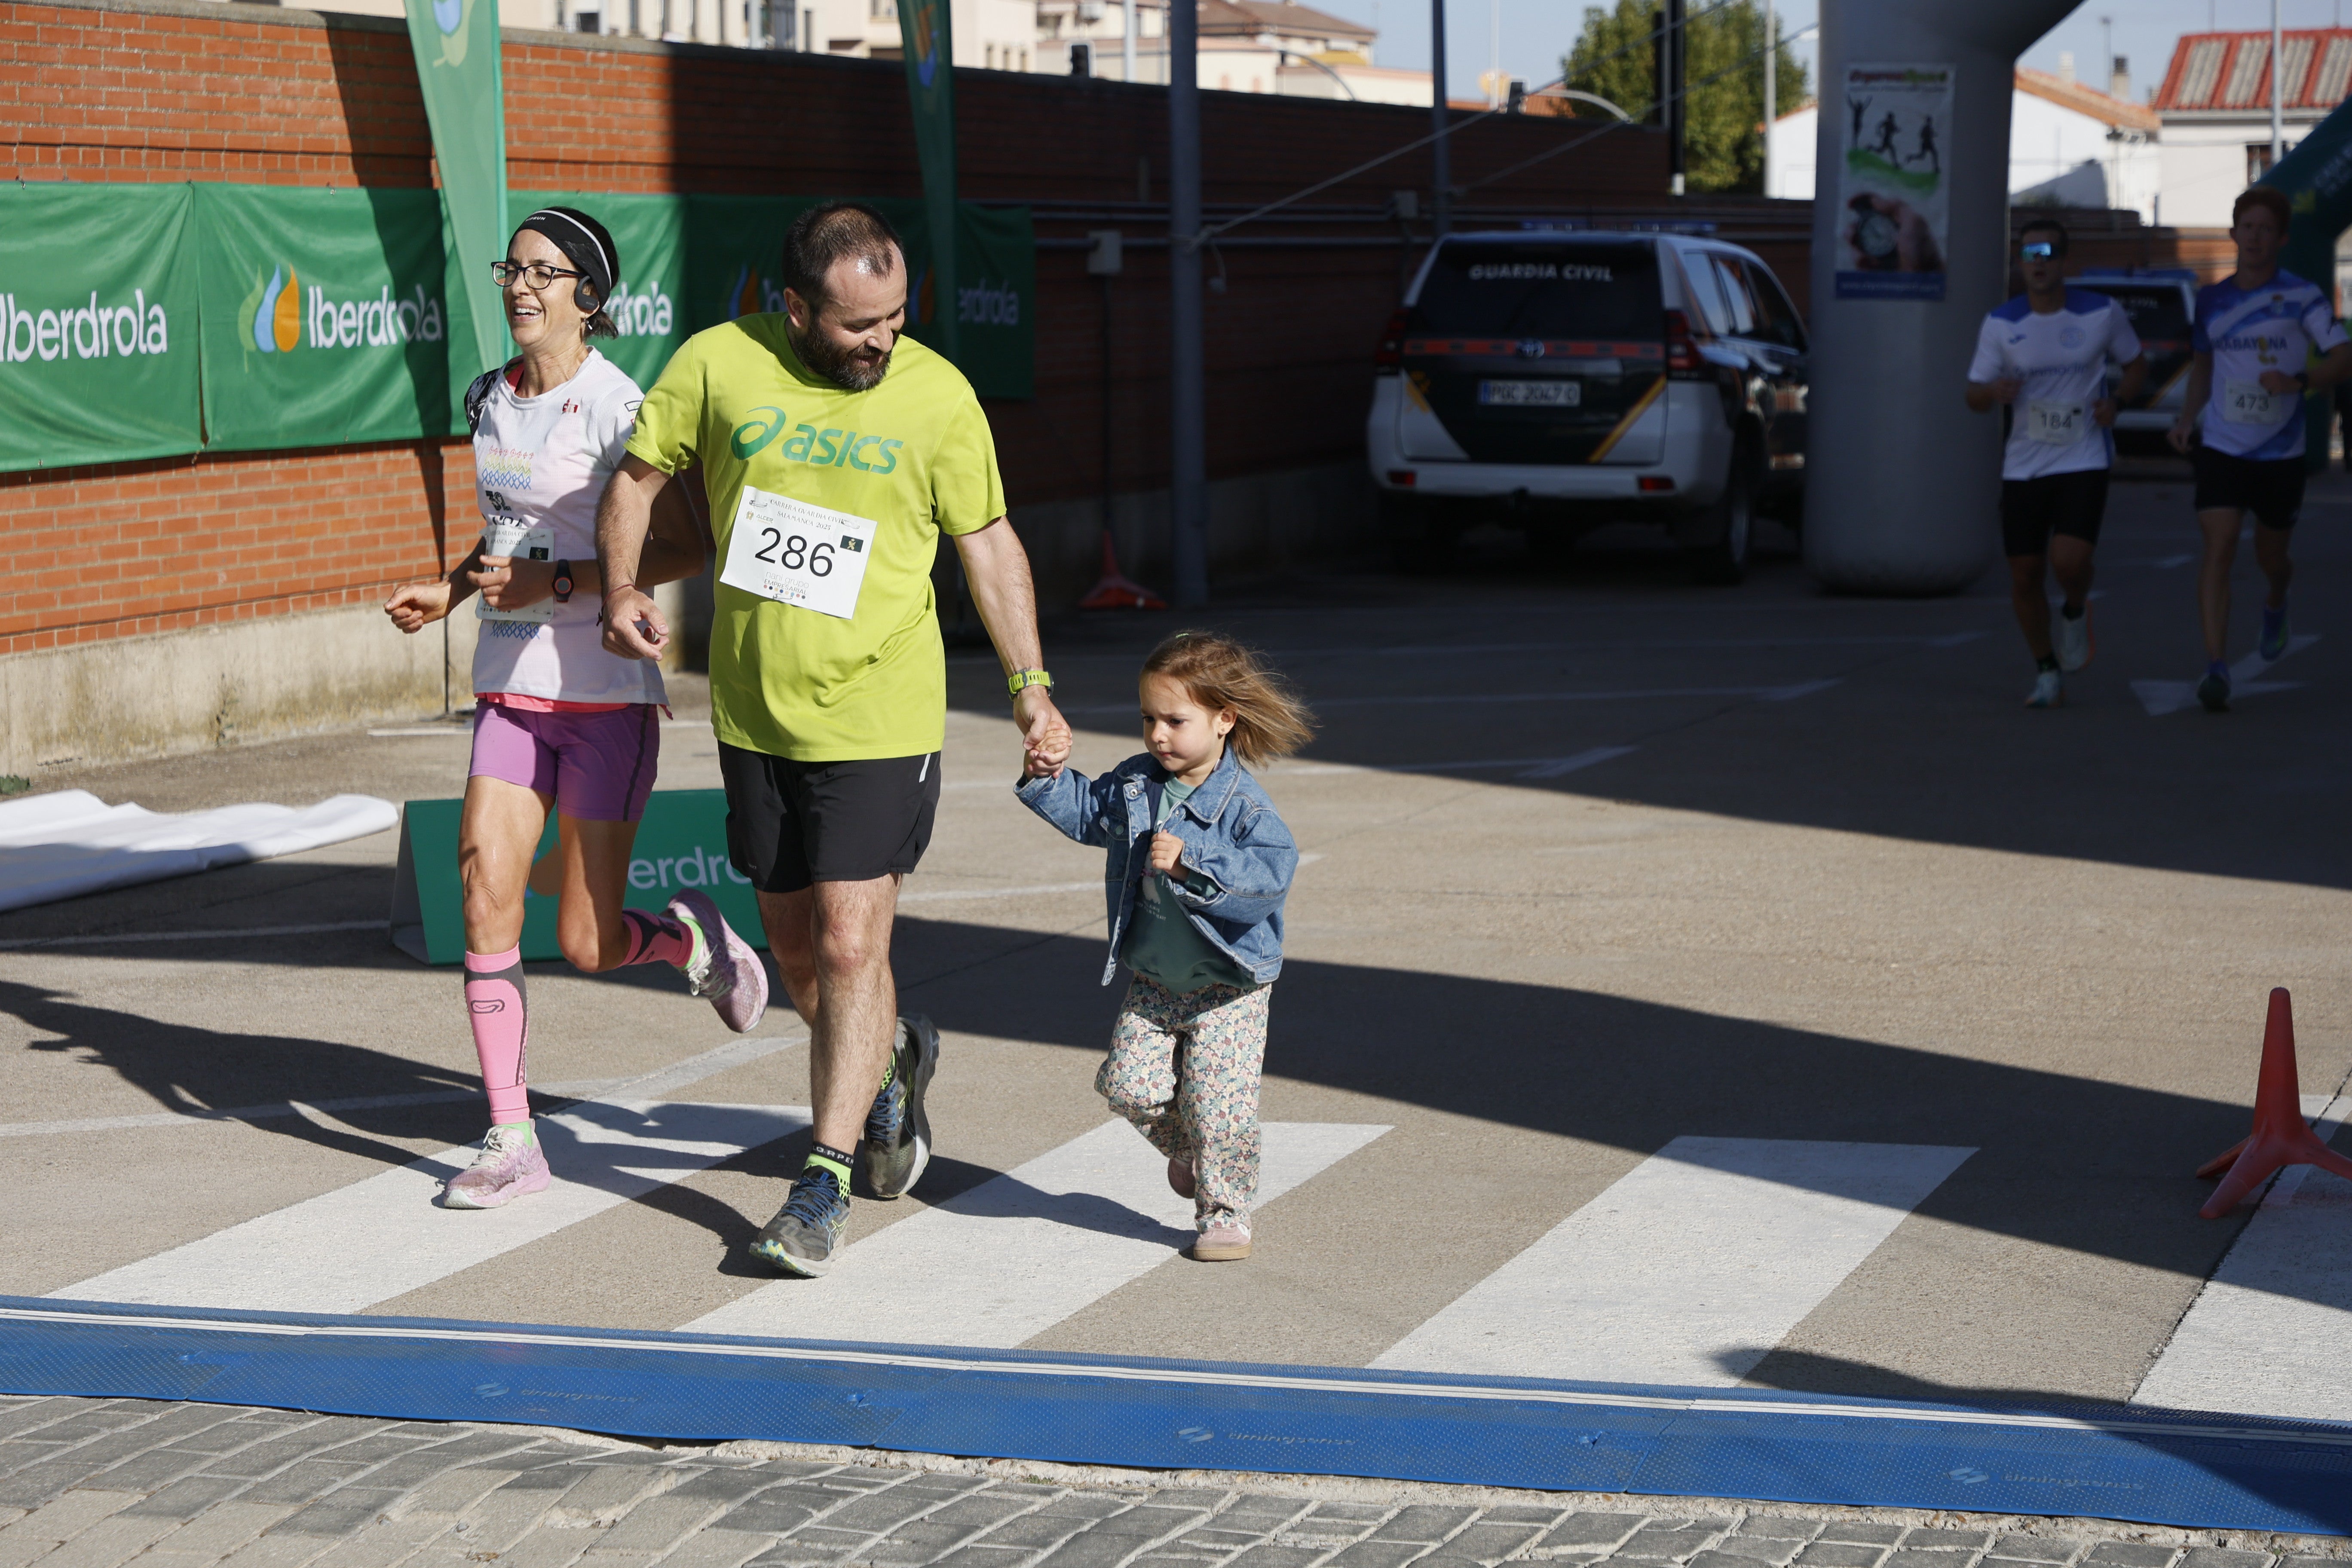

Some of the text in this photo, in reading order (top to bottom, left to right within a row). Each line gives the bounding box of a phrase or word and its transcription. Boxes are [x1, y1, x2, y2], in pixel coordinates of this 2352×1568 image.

[1467, 263, 1614, 282] GUARDIA CIVIL
[0, 288, 168, 363] Iberdrola
[308, 284, 443, 349] Iberdrola
[2236, 393, 2269, 412] 473
[2042, 412, 2072, 429] 184
[781, 424, 904, 475] asics
[756, 514, 774, 524] ALCER
[770, 499, 796, 512] CARRERA
[798, 507, 826, 520] GVARDIA
[777, 511, 814, 526] SALAMANCA
[816, 523, 831, 531] 2025
[755, 527, 836, 577] 286
[764, 579, 807, 595] EMPRESARIAL
[766, 572, 809, 588] nani grupo
